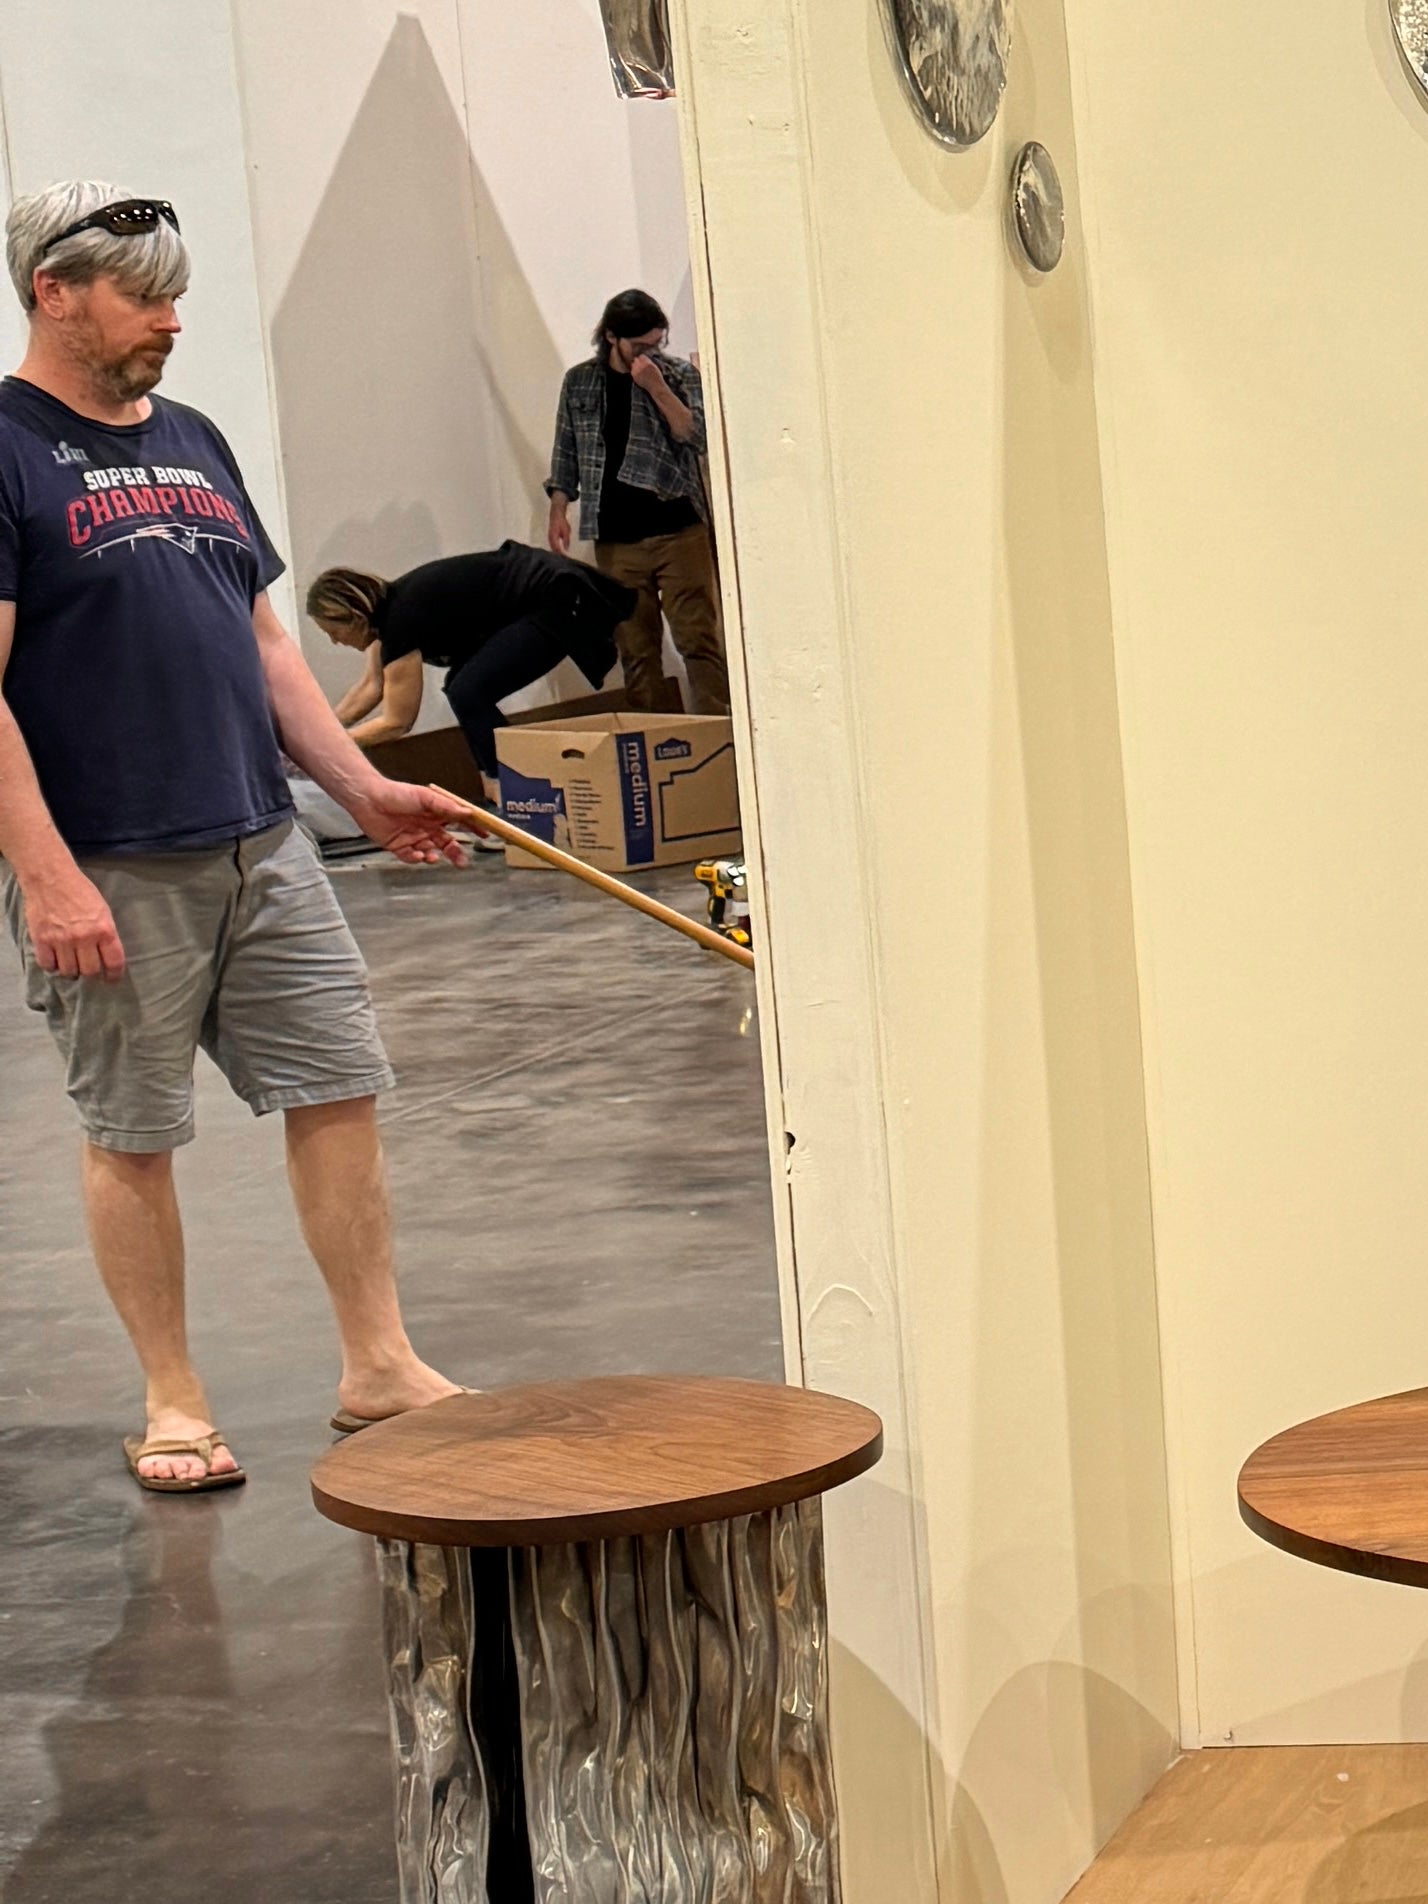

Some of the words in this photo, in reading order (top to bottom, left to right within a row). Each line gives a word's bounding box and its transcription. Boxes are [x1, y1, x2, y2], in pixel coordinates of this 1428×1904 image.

[83, 467, 150, 491] SUPER
[151, 466, 213, 490] BOWL
[66, 487, 250, 547] CHAMPIONS
[506, 798, 557, 813] medium
[628, 742, 648, 827] medium
